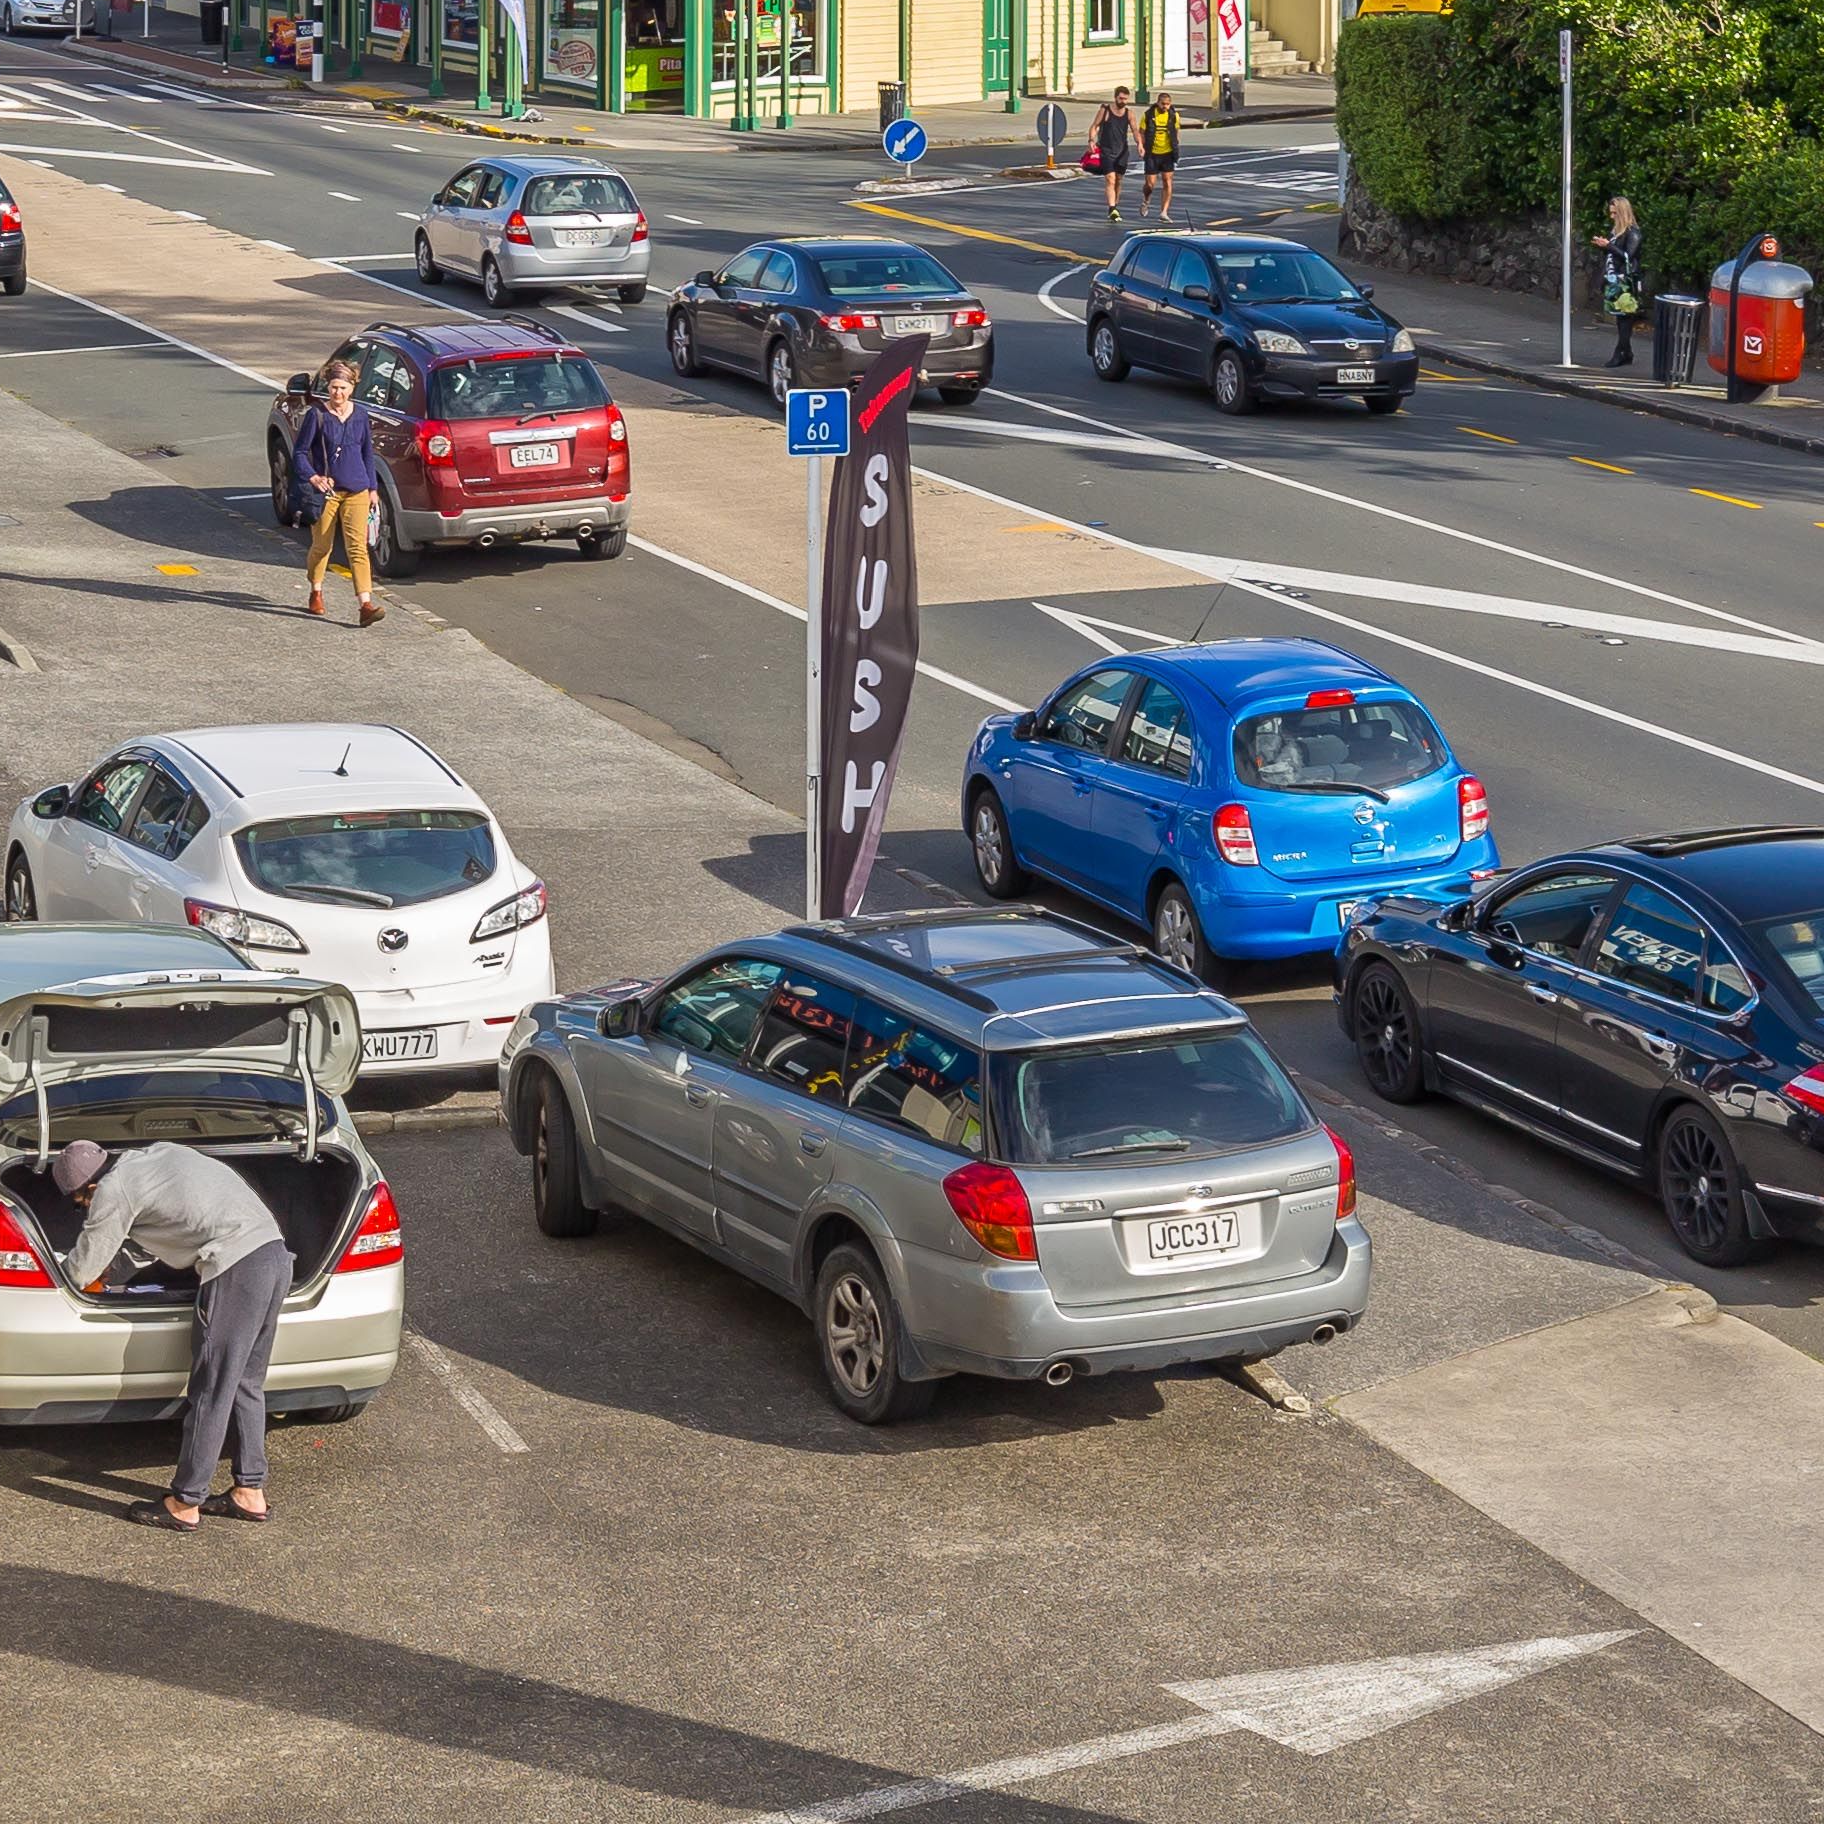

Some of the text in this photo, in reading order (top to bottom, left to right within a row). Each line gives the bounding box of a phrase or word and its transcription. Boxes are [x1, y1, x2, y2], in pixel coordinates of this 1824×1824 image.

[659, 58, 682, 71] Pita
[808, 394, 828, 418] P
[806, 421, 830, 441] 60
[517, 447, 553, 463] EEL74
[363, 1033, 435, 1058] KWU777
[1155, 1218, 1234, 1252] JCC317
